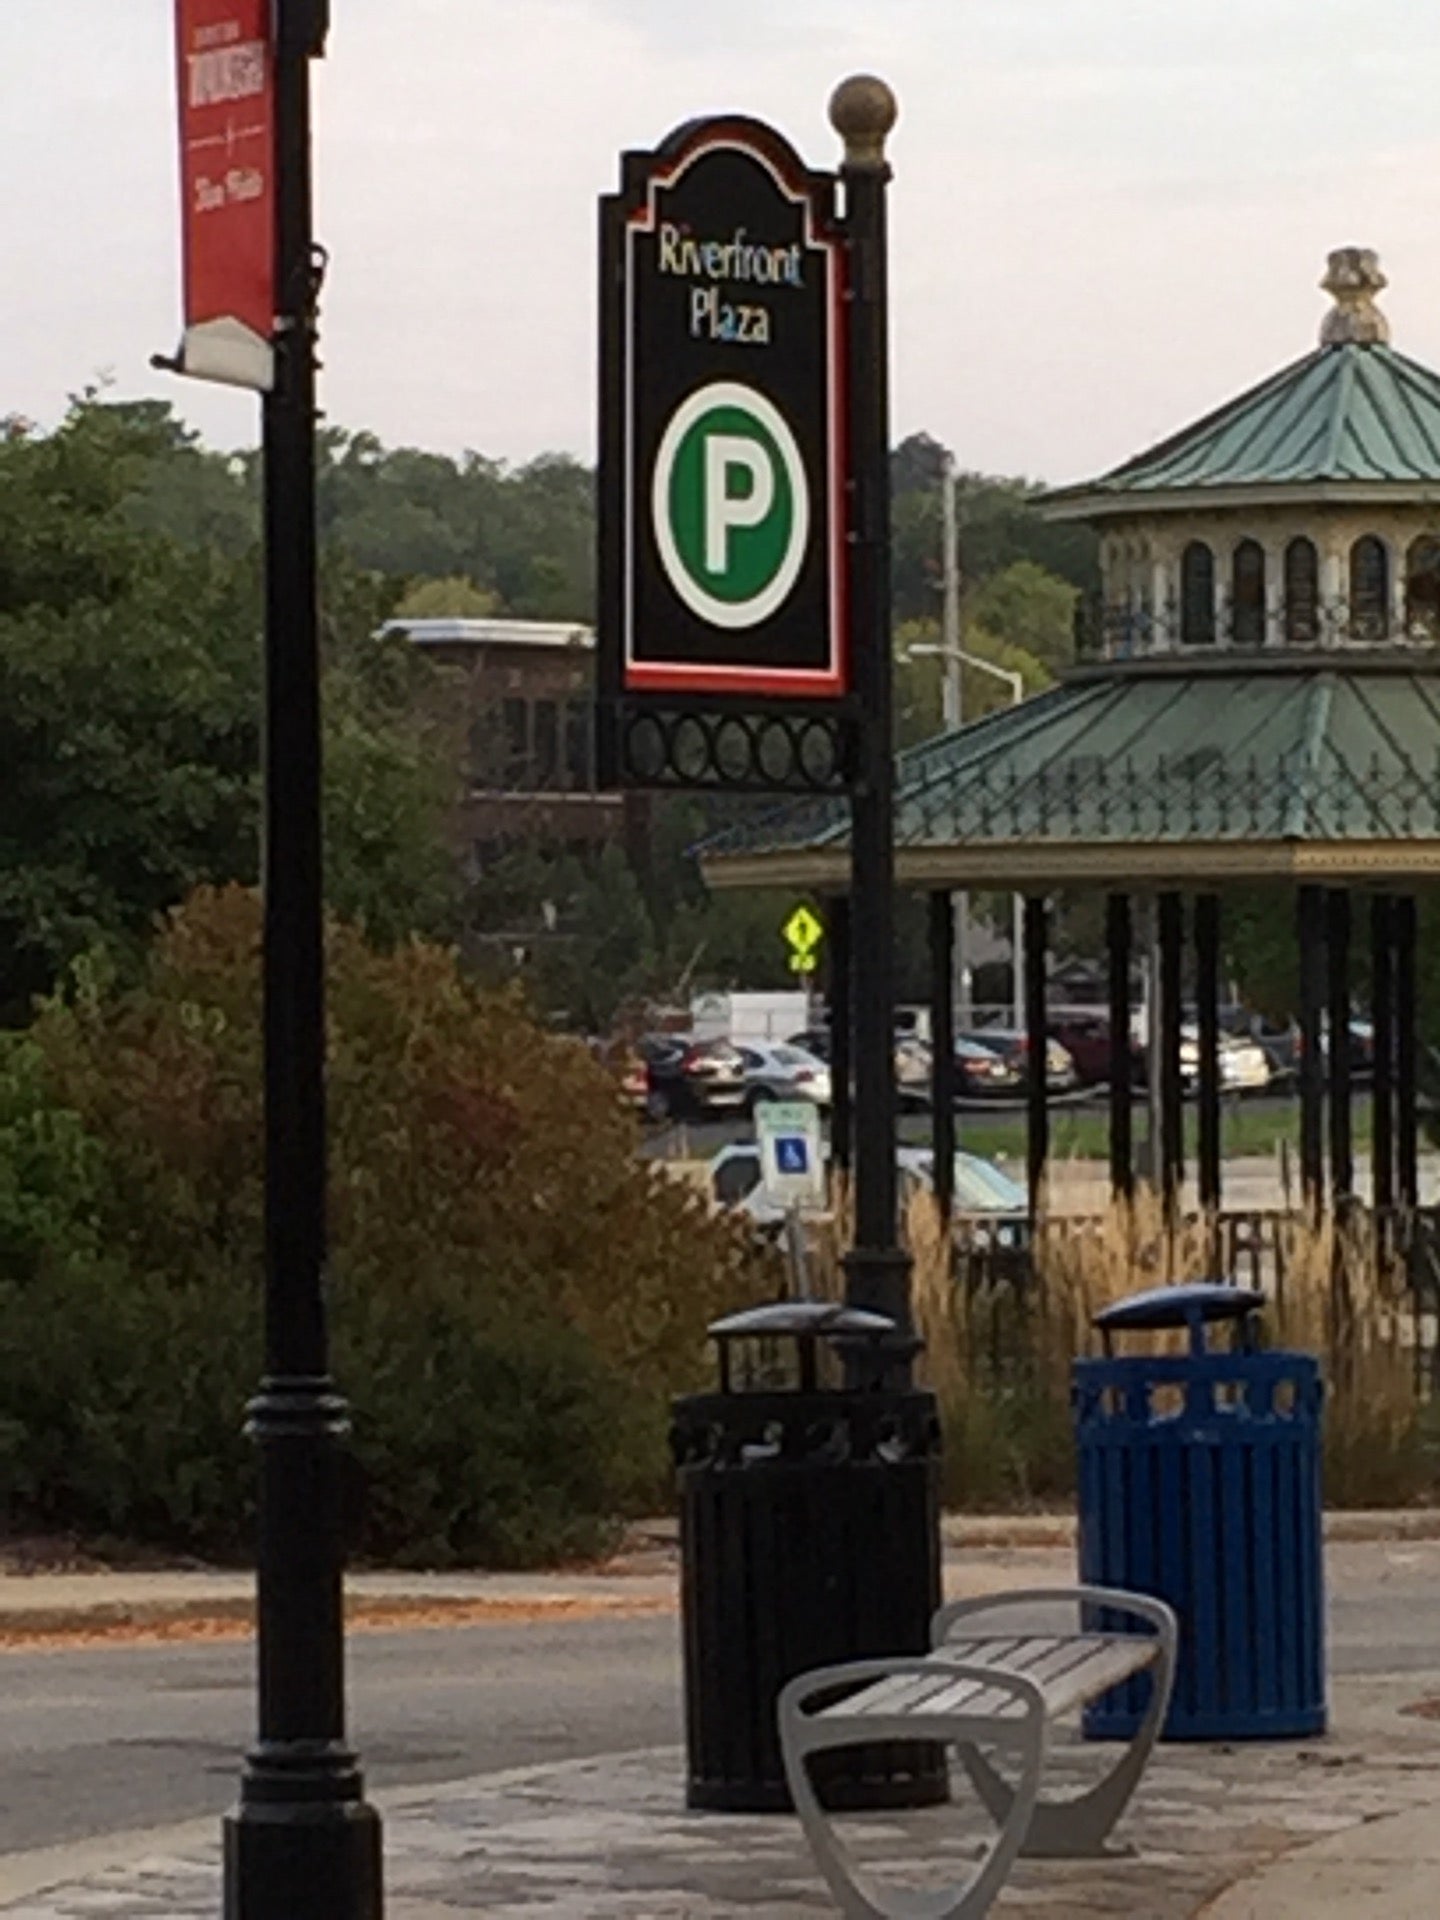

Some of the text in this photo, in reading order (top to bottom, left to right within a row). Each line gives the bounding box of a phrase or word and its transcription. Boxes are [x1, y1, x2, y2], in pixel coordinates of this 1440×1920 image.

[658, 222, 804, 288] Riverfront
[690, 285, 770, 343] Plaza
[705, 434, 775, 575] P
